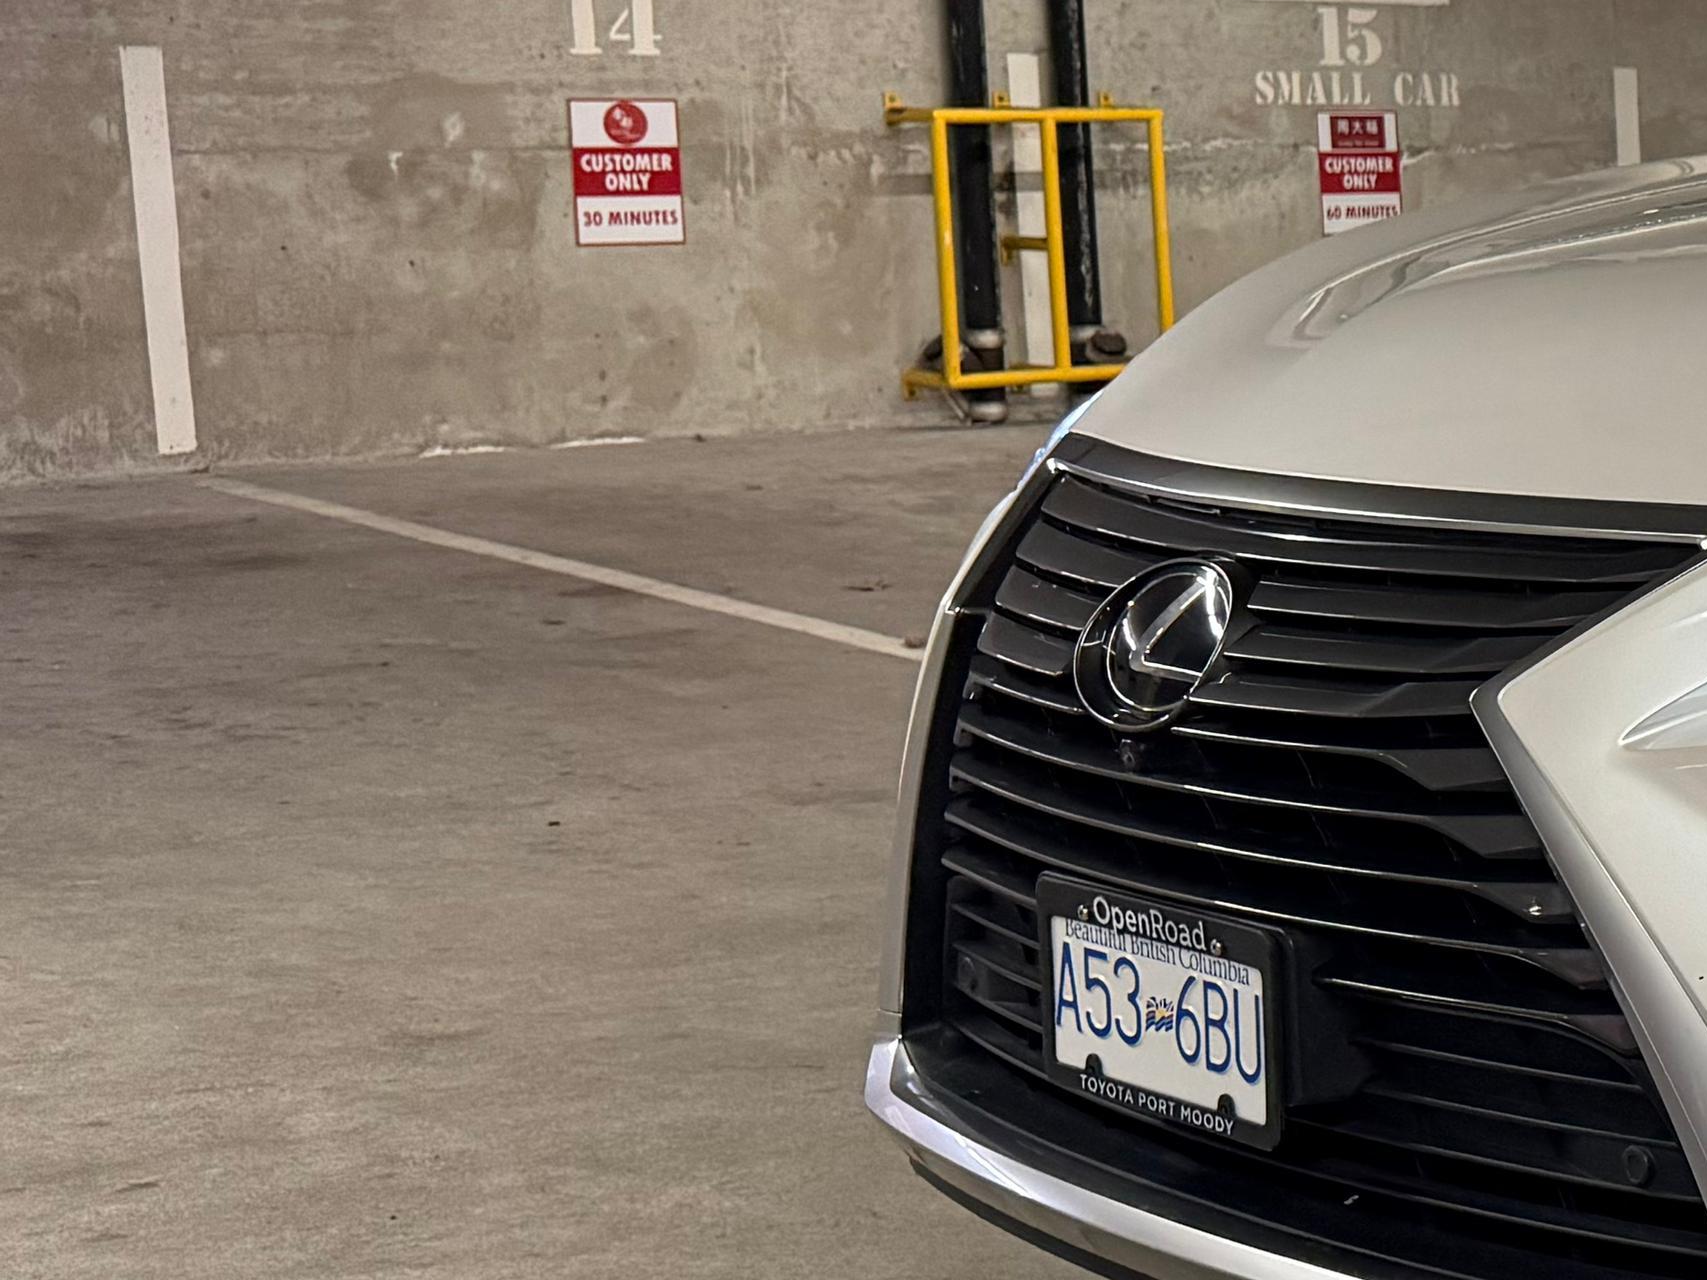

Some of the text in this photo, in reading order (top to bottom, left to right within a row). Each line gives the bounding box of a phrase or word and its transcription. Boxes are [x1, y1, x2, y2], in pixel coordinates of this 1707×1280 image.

[1317, 6, 1383, 67] 15
[1254, 70, 1461, 107] SMALL CAR
[580, 153, 672, 173] CUSTOMER
[1324, 157, 1394, 174] CUSTOMER
[605, 173, 651, 192] ONLY
[1343, 174, 1377, 190] ONLY
[583, 209, 678, 227] 30 MINUTES
[1327, 204, 1398, 221] 60 MINUTES
[1093, 896, 1207, 952] OpenRoad
[1056, 940, 1263, 1085] A53 6BU
[1080, 1073, 1234, 1136] TOYOTA PORT MOODY
